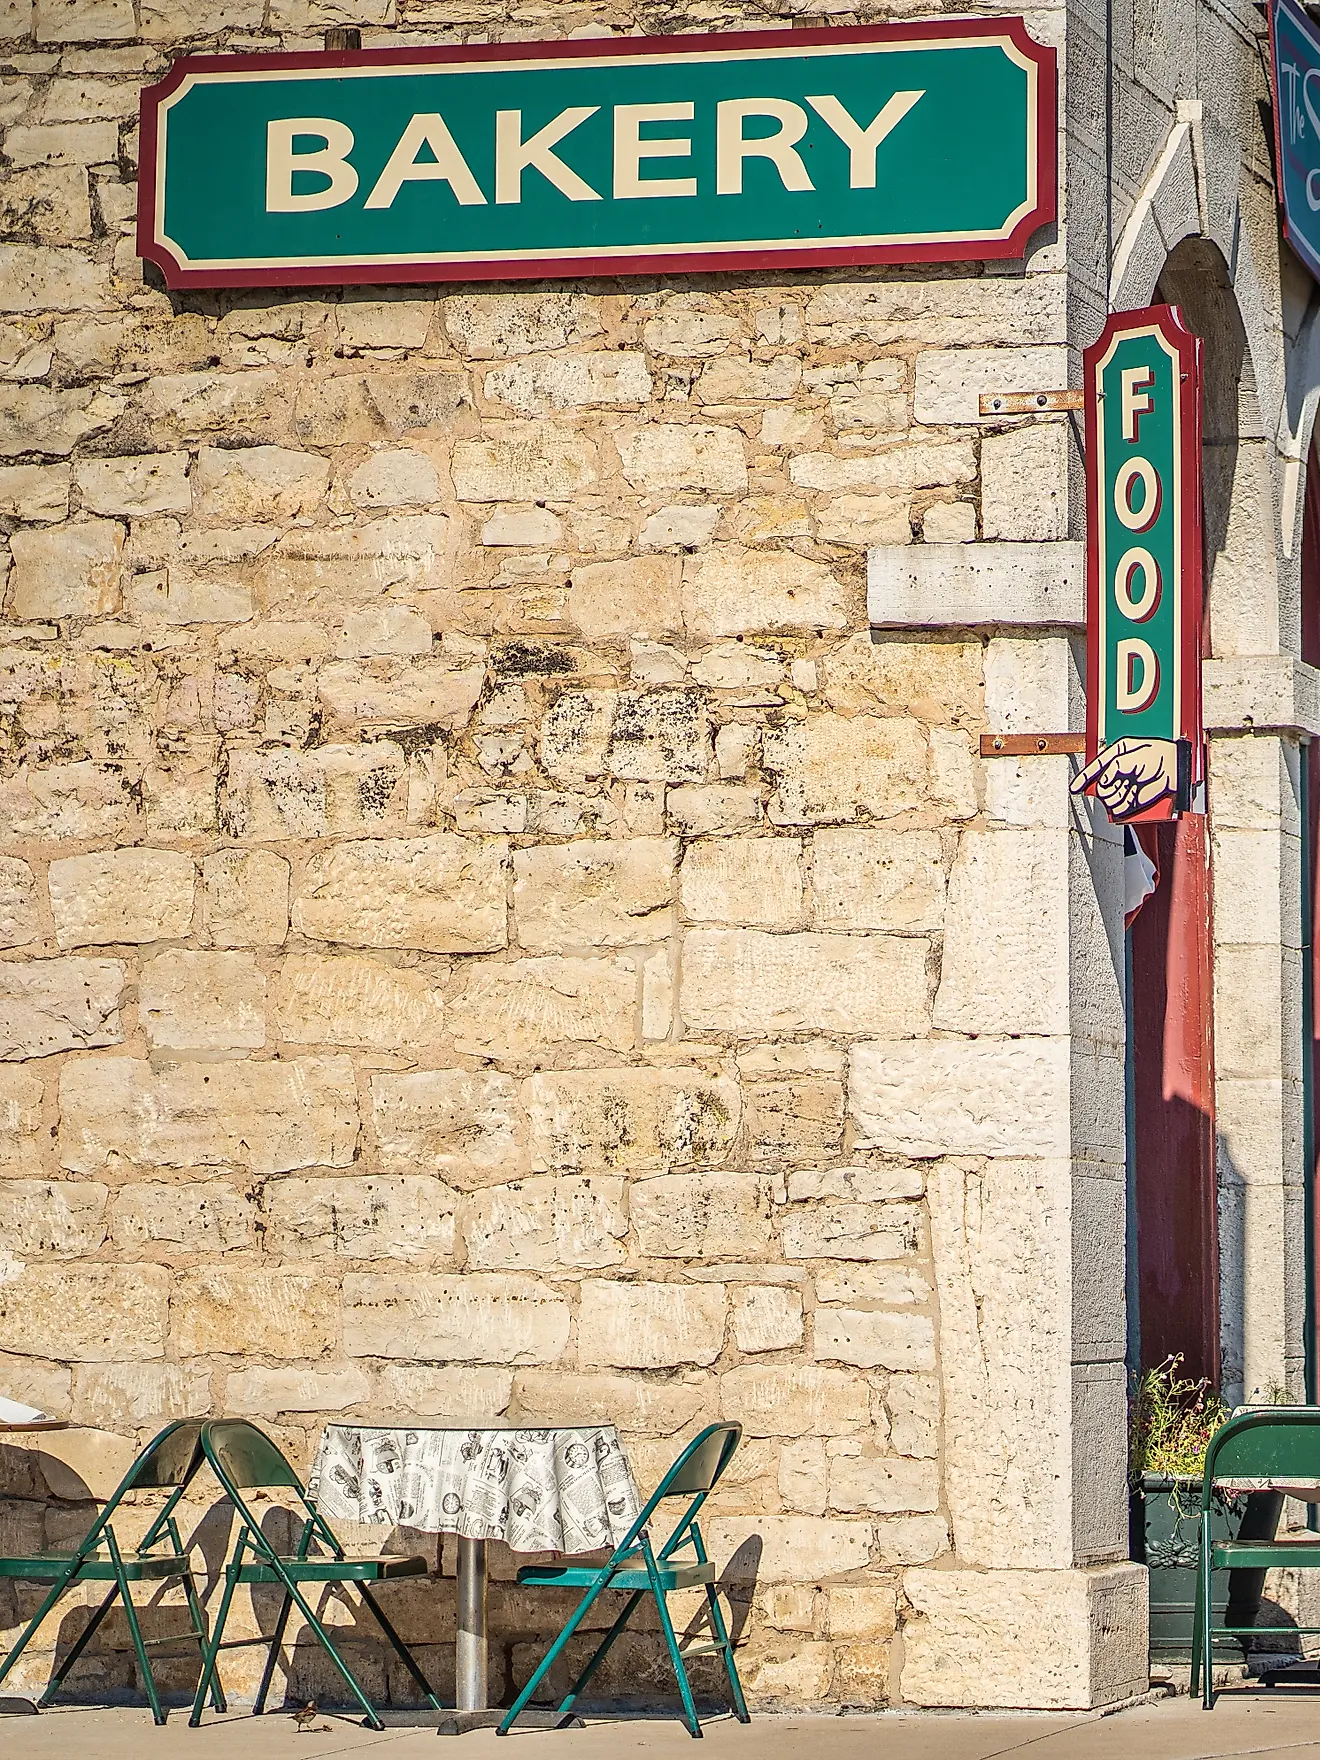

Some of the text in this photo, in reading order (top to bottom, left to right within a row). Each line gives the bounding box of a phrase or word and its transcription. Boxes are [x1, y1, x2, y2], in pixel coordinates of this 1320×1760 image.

[265, 90, 926, 212] BAKERY
[1282, 62, 1305, 144] The
[1114, 365, 1162, 715] FOOD
